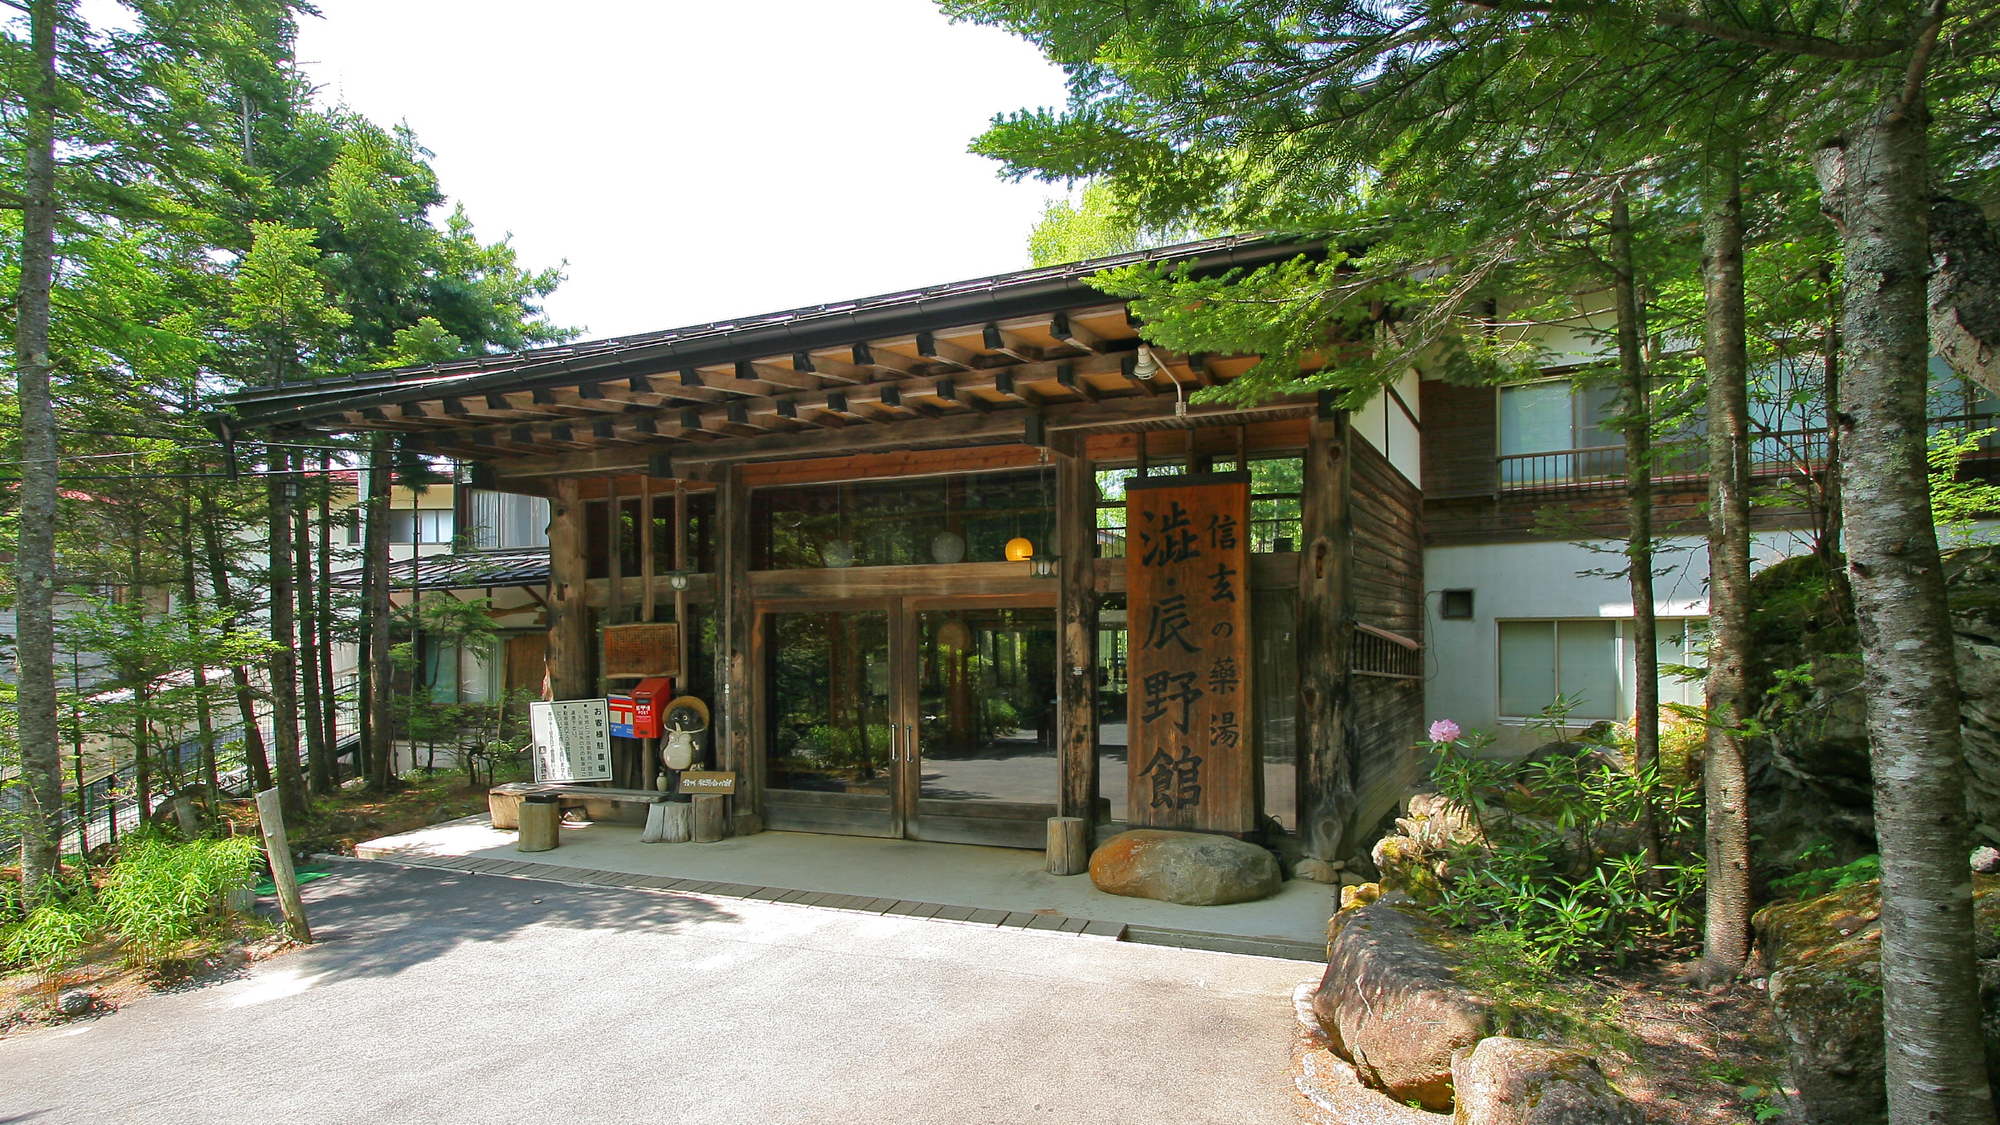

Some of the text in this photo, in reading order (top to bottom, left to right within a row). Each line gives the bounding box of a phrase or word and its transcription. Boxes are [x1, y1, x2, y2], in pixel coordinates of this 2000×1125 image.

[593, 707, 605, 772] お客様駐車場
[1139, 501, 1203, 810] 澁・辰野館
